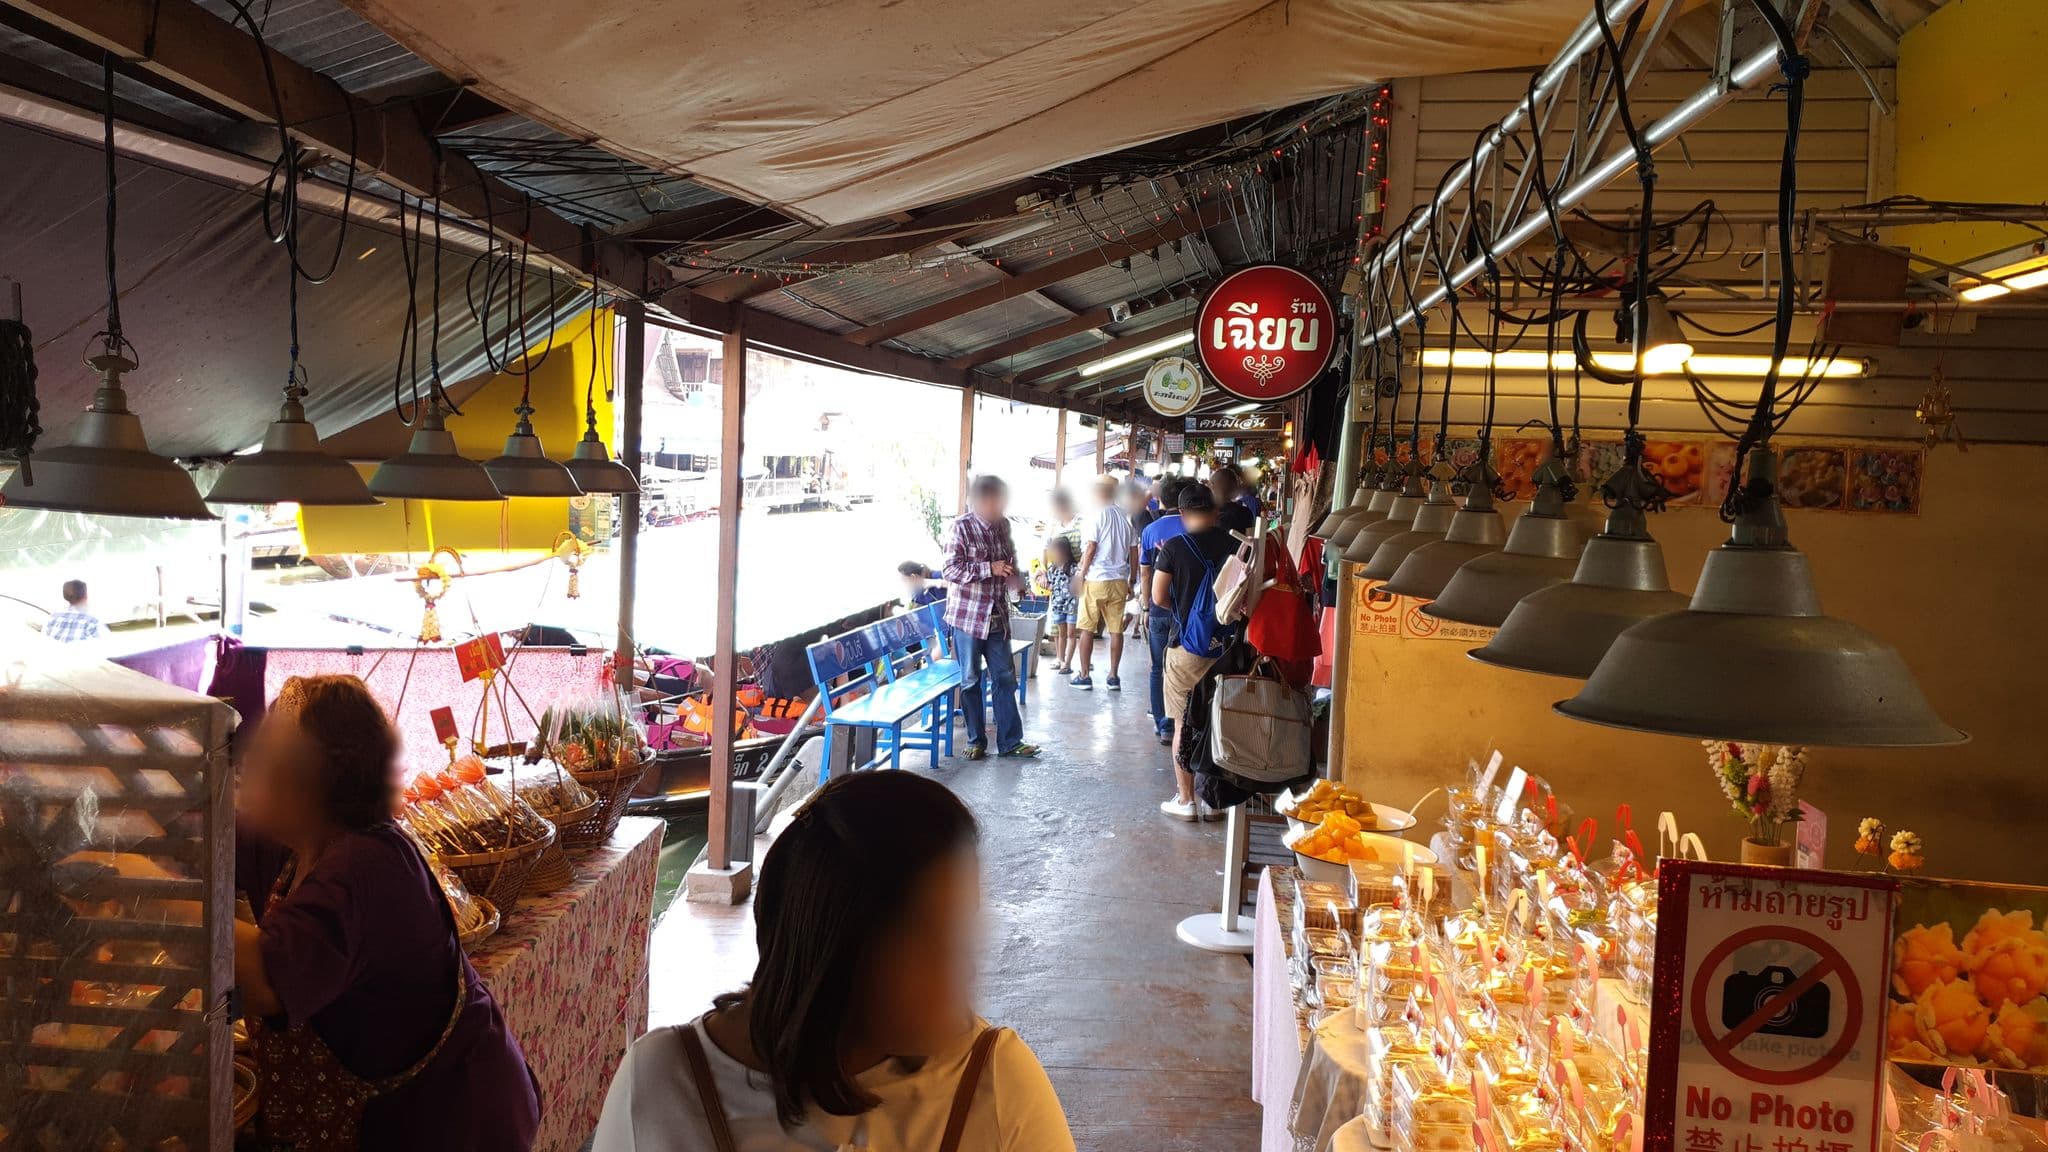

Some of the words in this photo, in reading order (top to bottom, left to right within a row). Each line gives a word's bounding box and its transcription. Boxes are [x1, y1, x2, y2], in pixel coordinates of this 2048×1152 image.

[1213, 302, 1320, 351] เฉียบ
[1290, 298, 1317, 314] ร้าน
[1360, 613, 1371, 622] No
[1374, 614, 1398, 623] Photo
[1699, 874, 1870, 931] ห้ามถ่ายรูป
[1685, 1085, 1733, 1121] No
[1749, 1091, 1855, 1134] Photo
